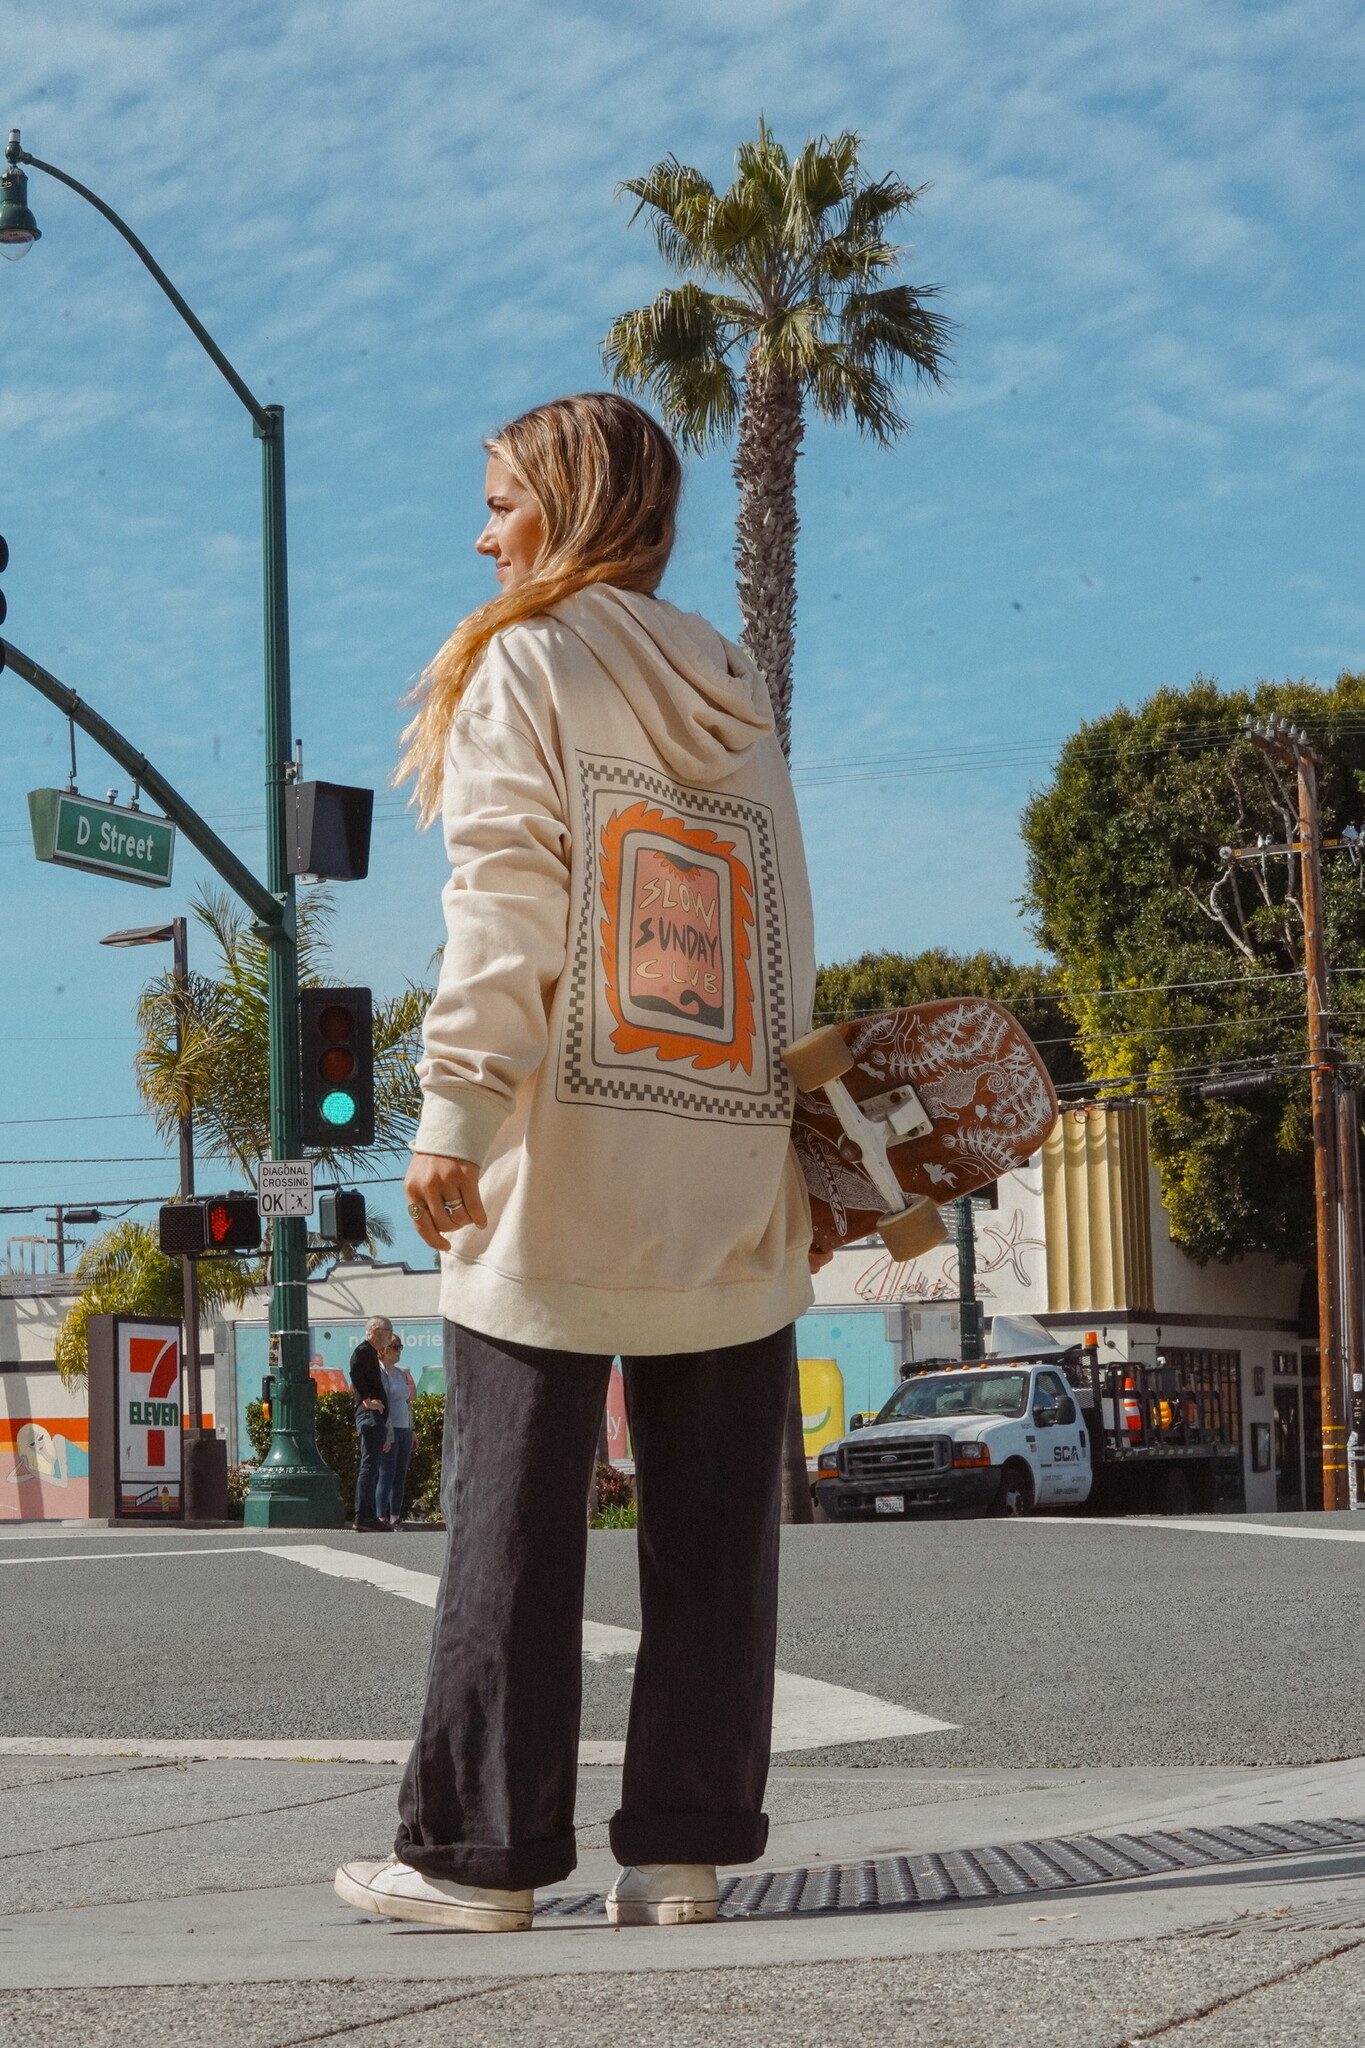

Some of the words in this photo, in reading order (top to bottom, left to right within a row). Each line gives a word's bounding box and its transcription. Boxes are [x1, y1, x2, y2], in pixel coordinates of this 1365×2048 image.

[77, 815, 91, 846] D
[99, 821, 154, 862] Street
[638, 878, 717, 931] SLOW
[634, 916, 718, 969] SUNDAY
[635, 959, 719, 994] CLUB
[262, 1166, 309, 1176] DIAGONAL
[262, 1178, 309, 1188] CROSSING
[261, 1193, 284, 1212] OK
[1053, 1445, 1080, 1462] SCA
